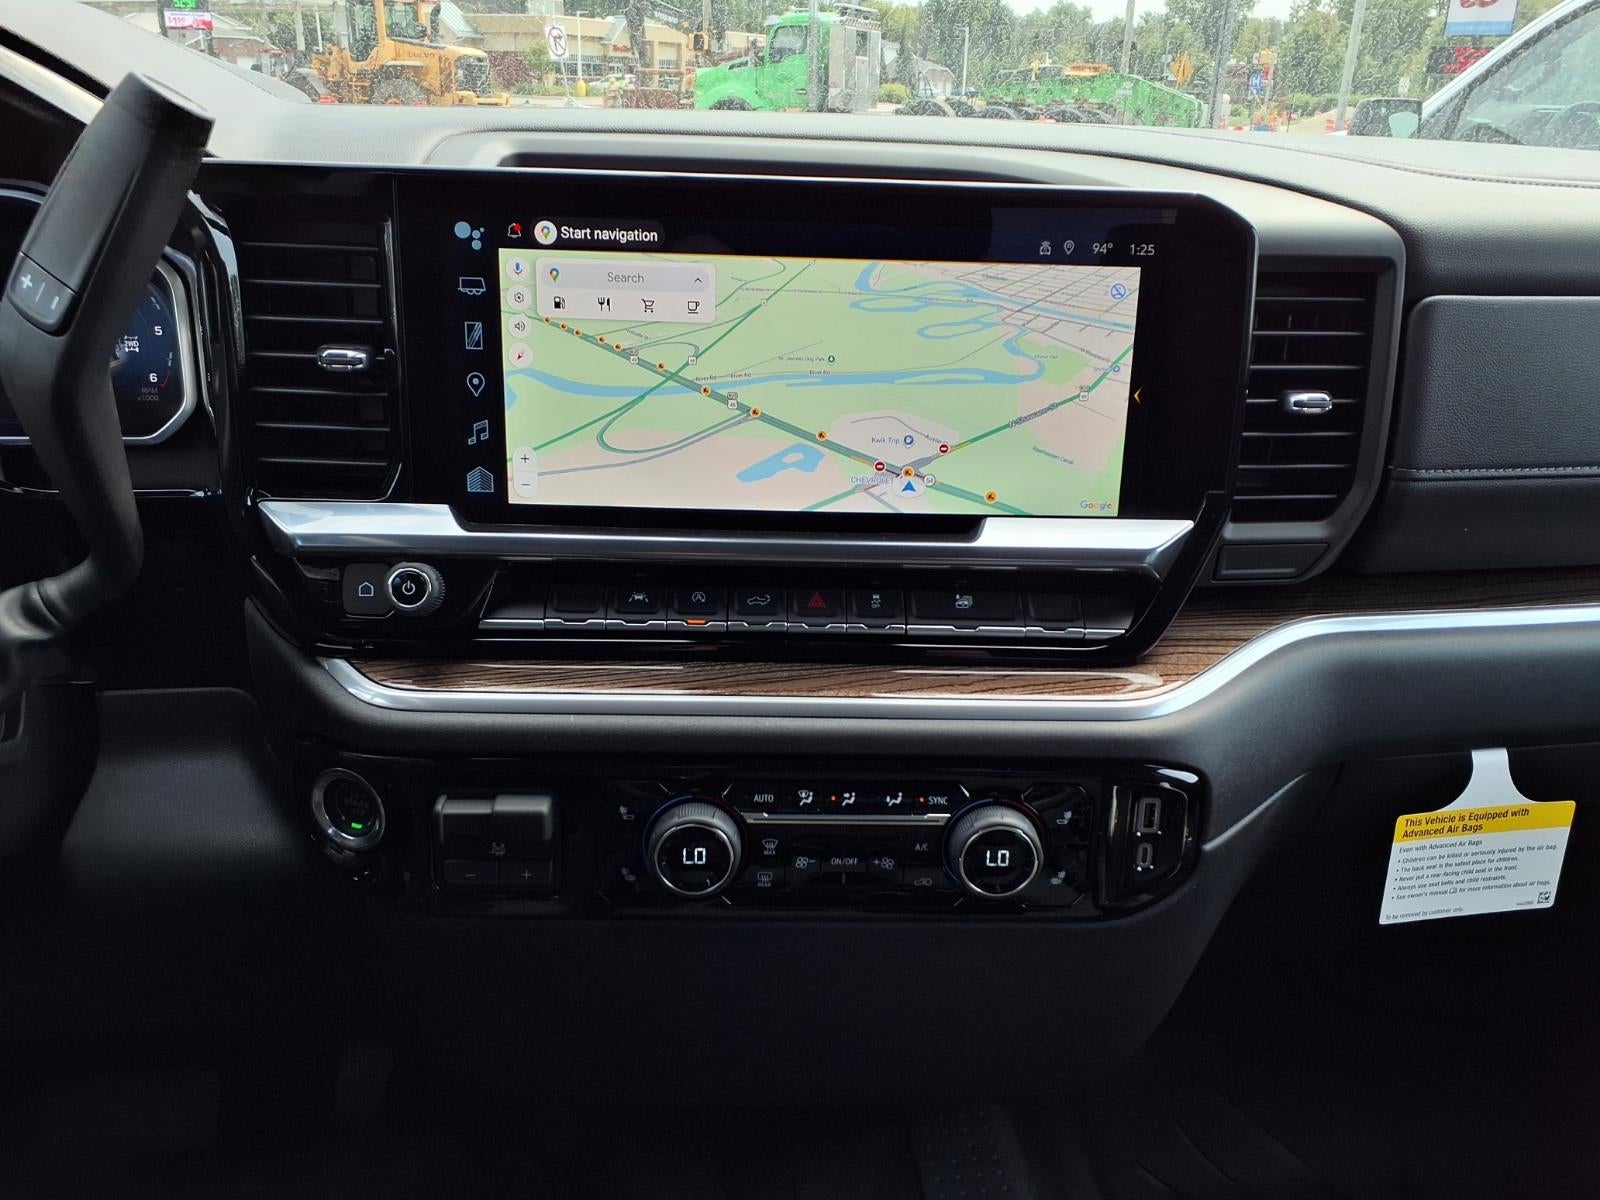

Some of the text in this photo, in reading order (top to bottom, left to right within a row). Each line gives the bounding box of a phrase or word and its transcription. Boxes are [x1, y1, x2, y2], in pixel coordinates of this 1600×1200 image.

[561, 226, 658, 244] Start navigation
[1130, 243, 1155, 256] 1:25
[607, 271, 645, 284] Search
[154, 325, 163, 336] 5
[149, 372, 158, 382] 6
[888, 437, 900, 445] Trip
[1080, 500, 1112, 511] Google
[753, 794, 774, 802] AUTO
[928, 796, 948, 805] SYNC
[1405, 807, 1530, 828] This Vehicle is Equipped with
[1402, 822, 1483, 838] Advanced Air Bags
[914, 842, 929, 851] A/C
[1429, 841, 1457, 850] Advanced
[1468, 839, 1482, 847] Bags
[831, 857, 859, 866] ON/OFF
[1402, 856, 1426, 864] Children
